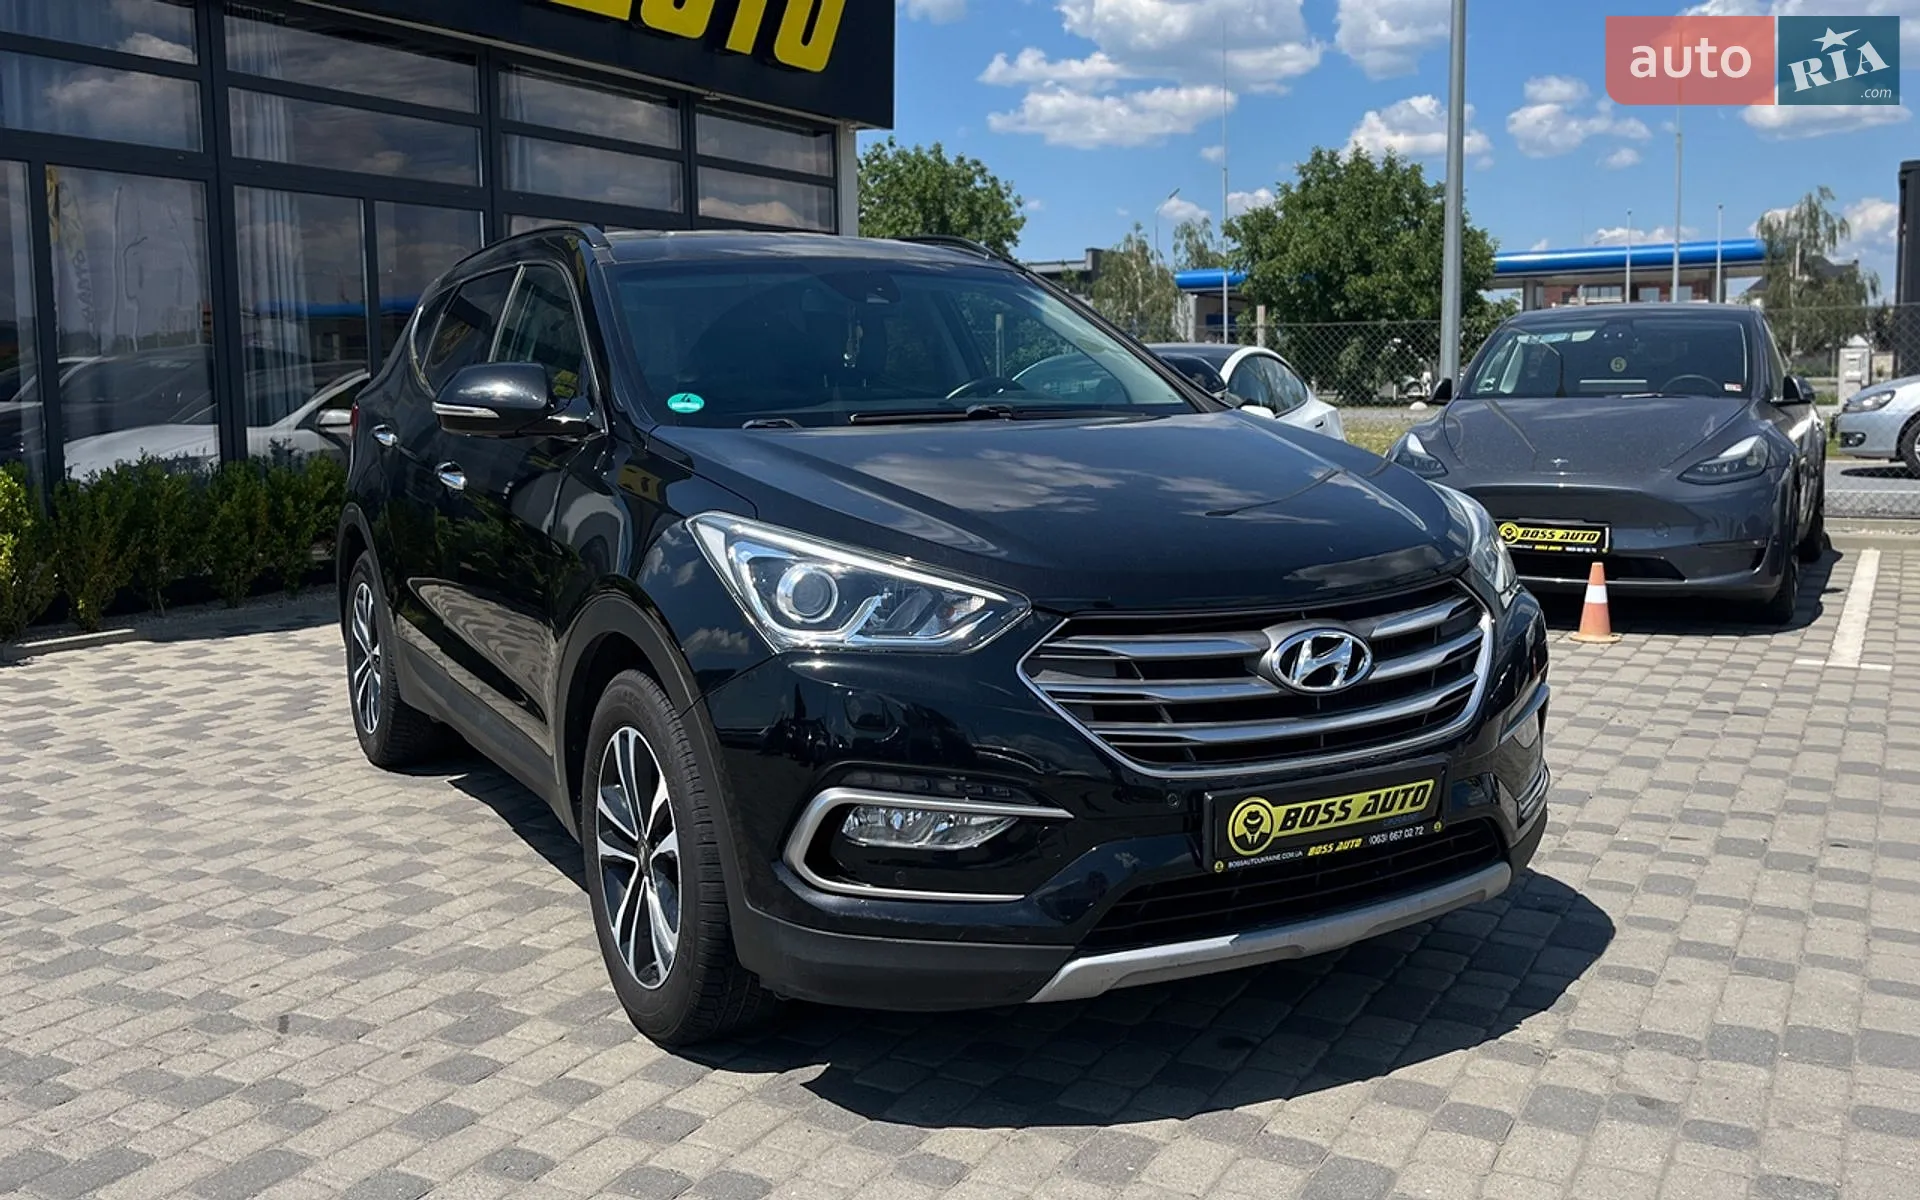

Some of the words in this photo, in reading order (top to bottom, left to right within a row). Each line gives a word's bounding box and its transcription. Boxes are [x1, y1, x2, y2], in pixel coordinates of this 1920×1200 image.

[1520, 528, 1556, 540] BOSS
[1559, 531, 1598, 541] AUTO
[1278, 798, 1354, 832] BOSS
[1358, 784, 1429, 818] AUTO
[1307, 843, 1335, 856] BOSS
[1335, 838, 1363, 852] AUTO
